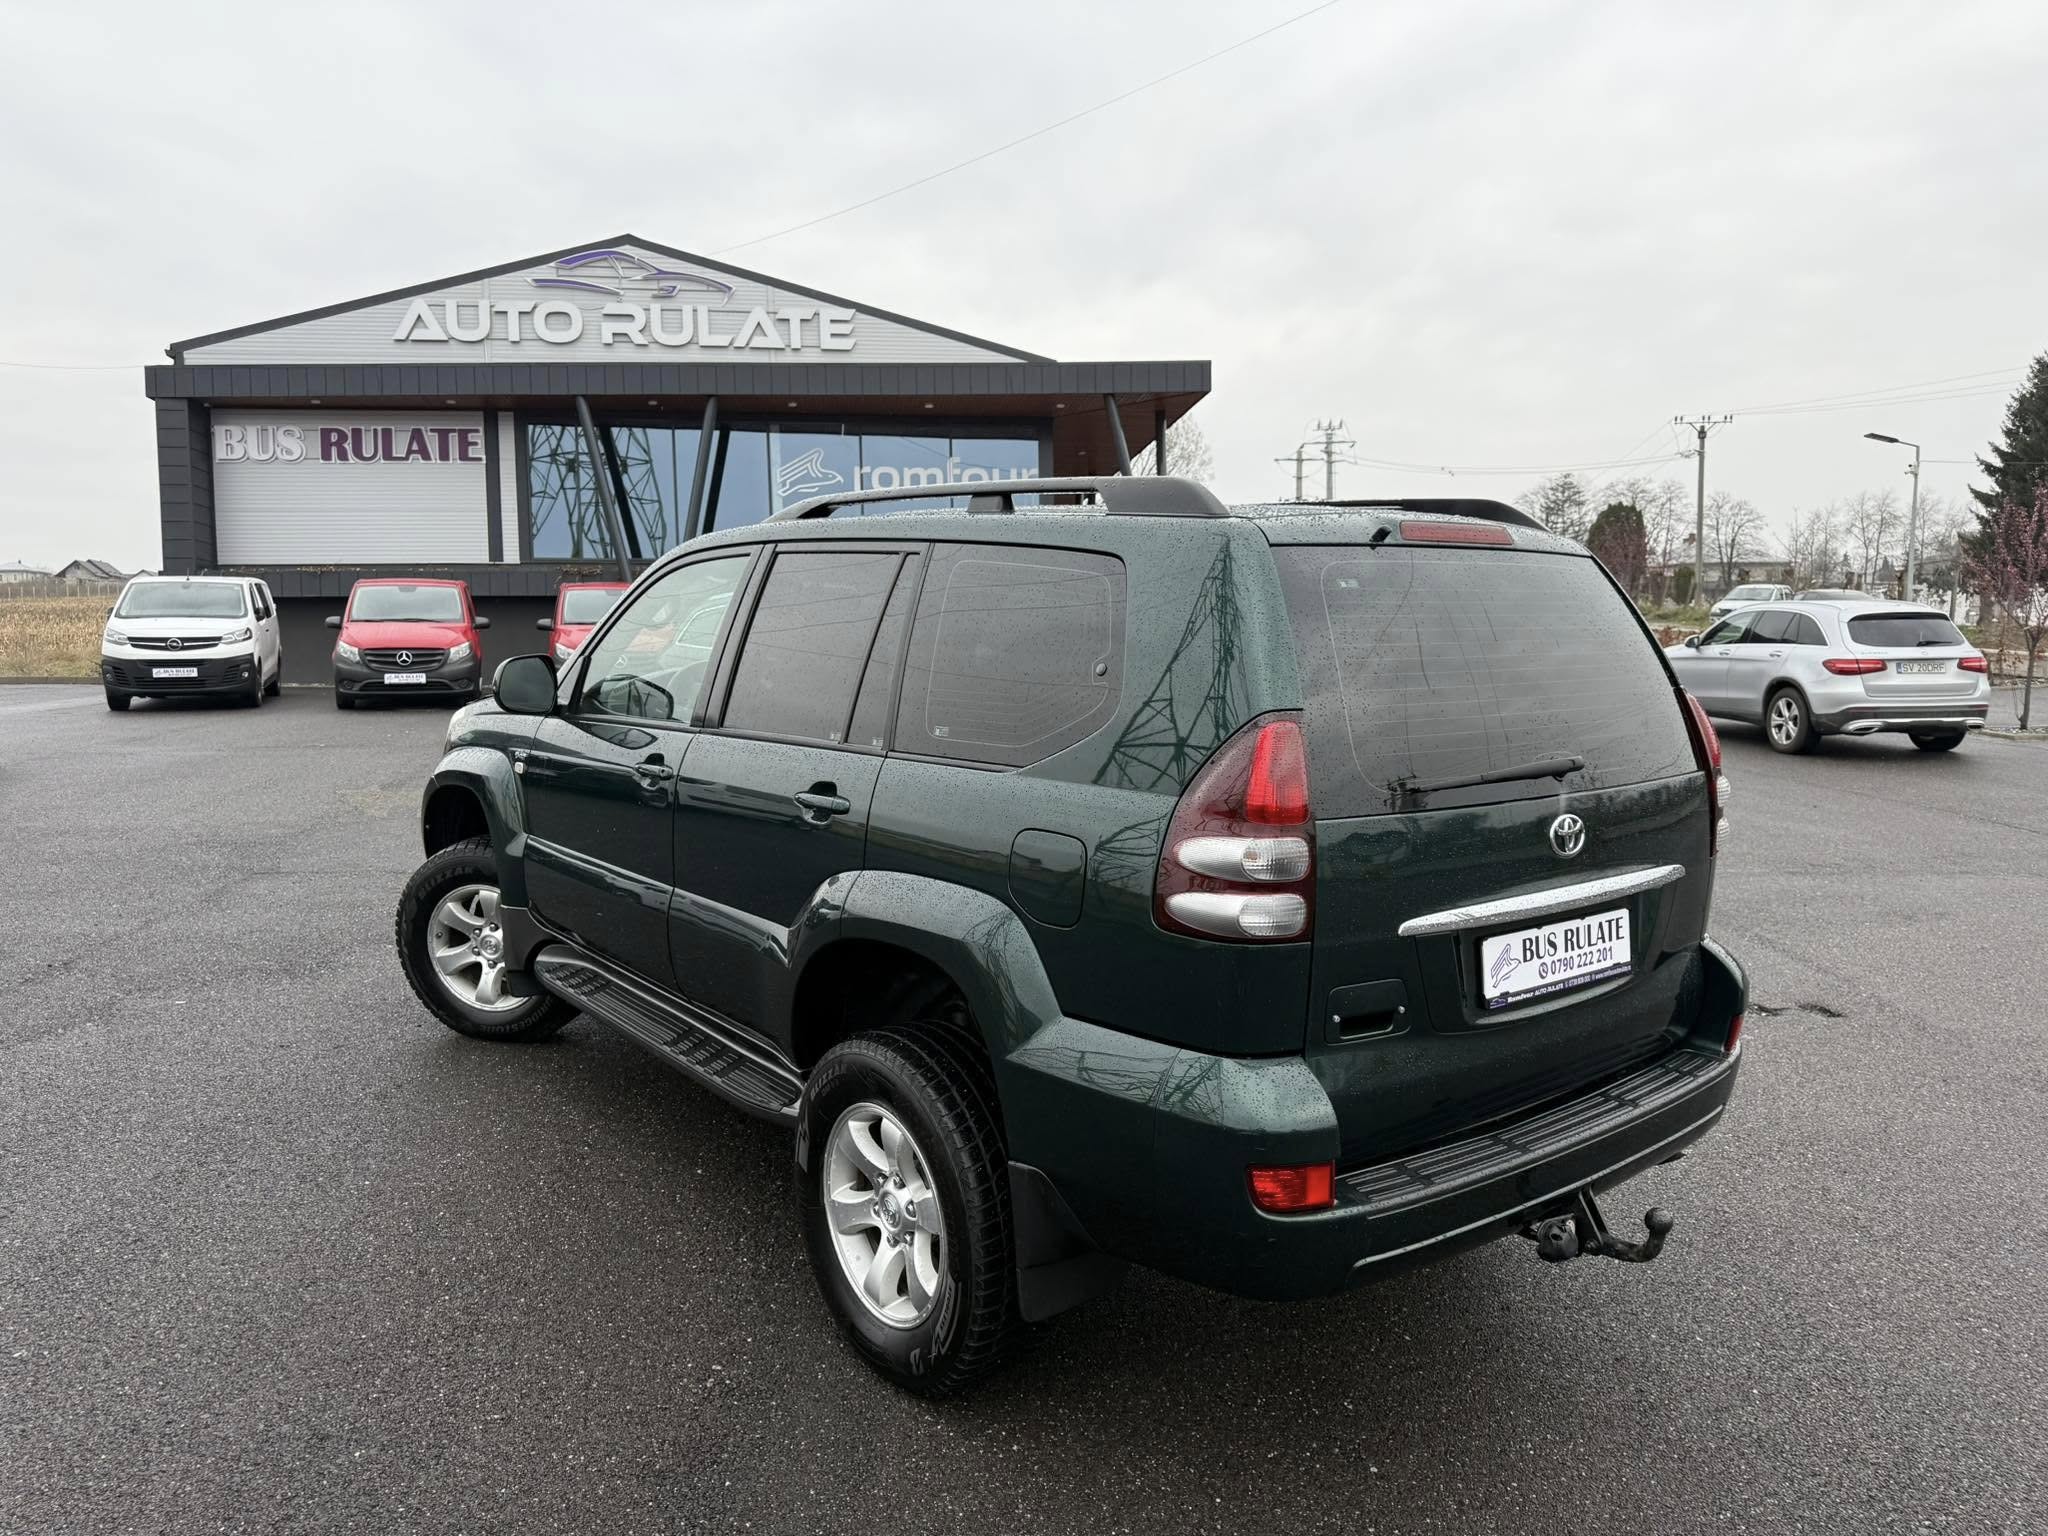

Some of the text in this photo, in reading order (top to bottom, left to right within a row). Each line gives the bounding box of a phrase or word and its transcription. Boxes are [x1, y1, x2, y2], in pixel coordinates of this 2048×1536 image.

[392, 300, 857, 351] AUTO RULATE
[213, 424, 486, 464] BUS RULATE
[1522, 916, 1625, 963] BUS RULATE
[1550, 955, 1575, 976] 0790
[1577, 950, 1594, 968] 222
[1596, 945, 1613, 963] 201
